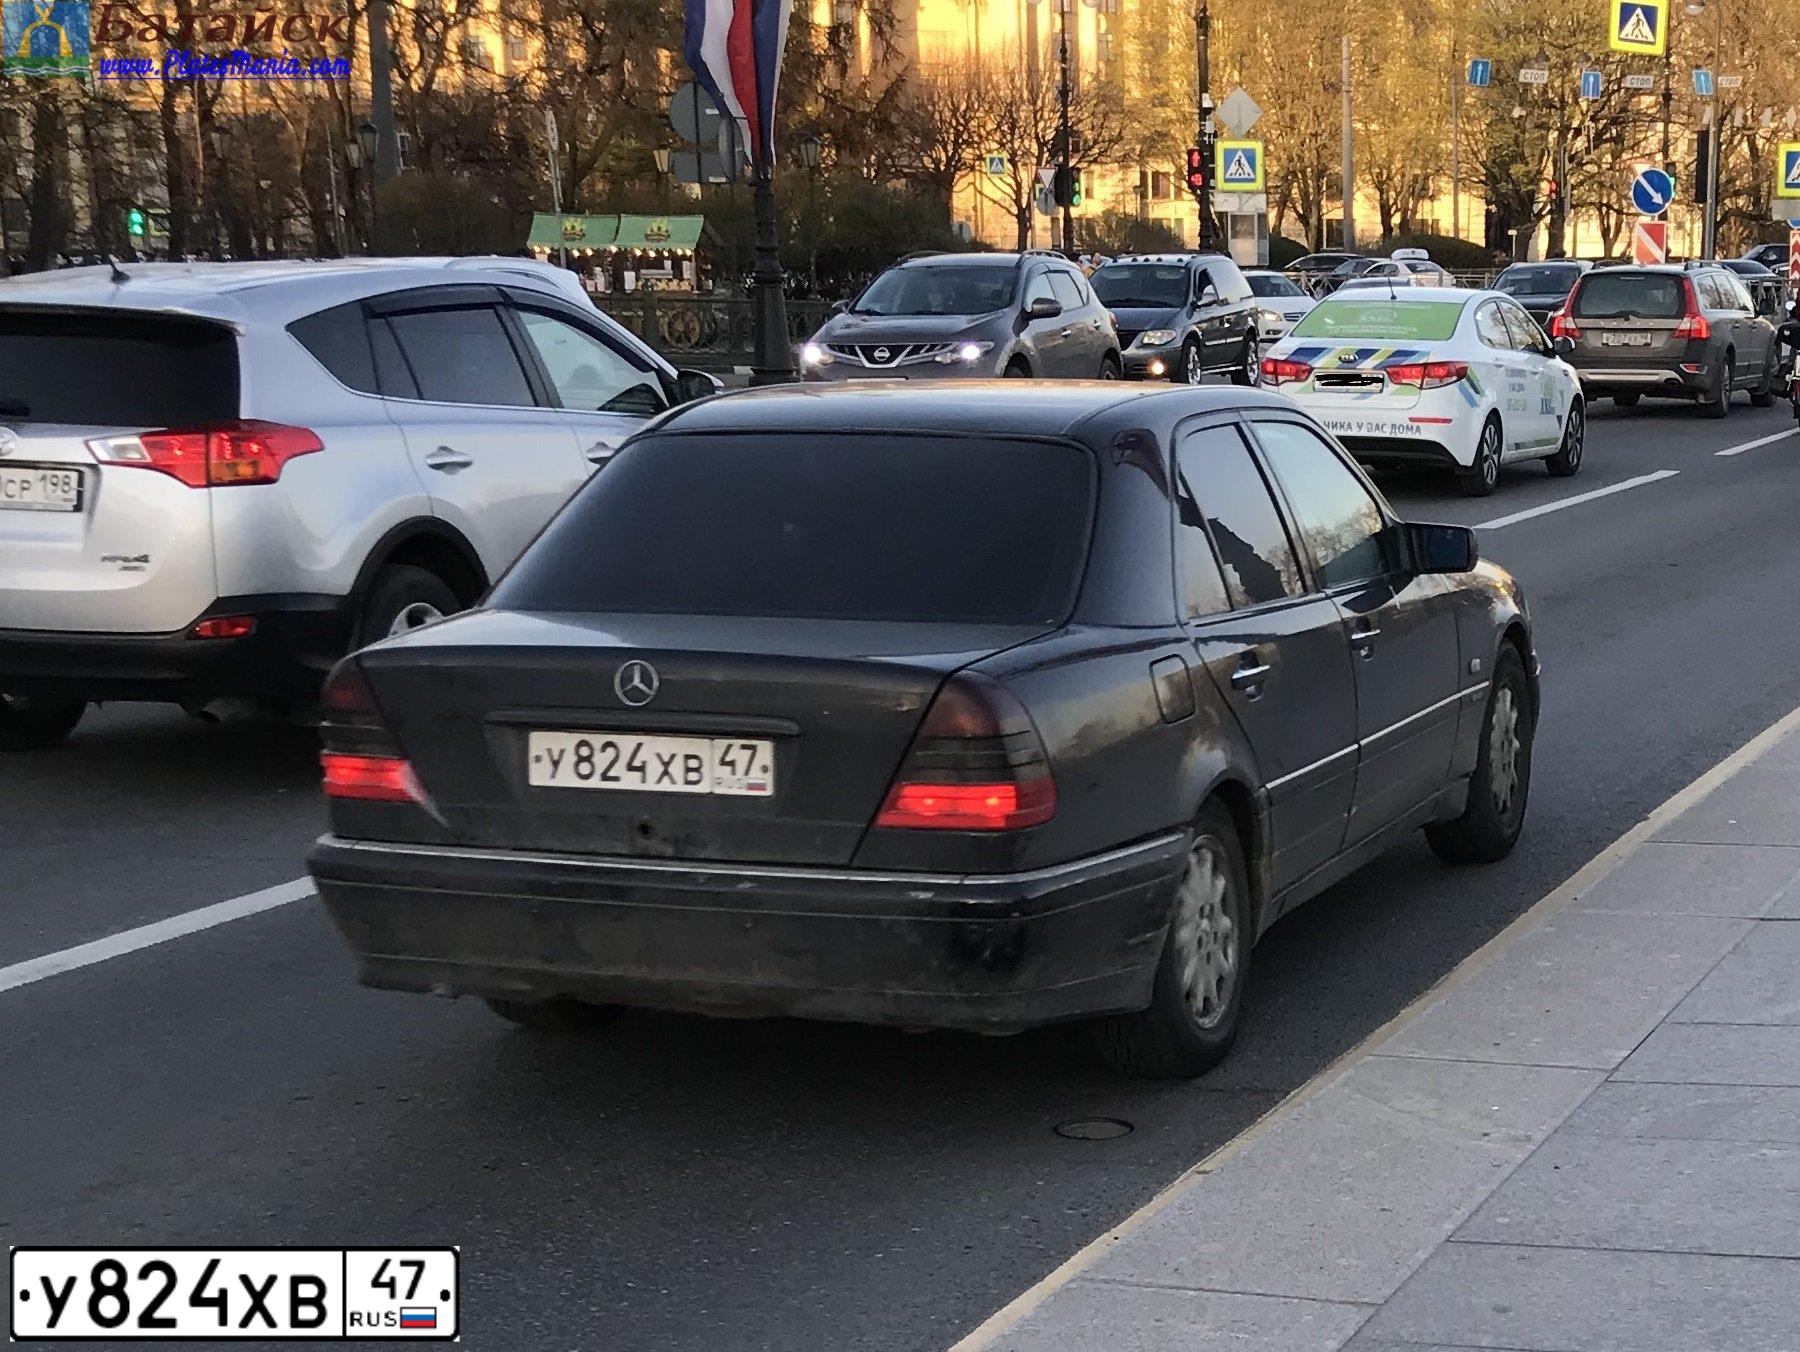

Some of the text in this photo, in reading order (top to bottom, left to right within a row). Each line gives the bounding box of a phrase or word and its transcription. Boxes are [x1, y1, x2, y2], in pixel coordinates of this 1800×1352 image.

[1522, 71, 1546, 82] СТОП
[1628, 76, 1651, 87] СТОП
[1718, 77, 1739, 86] СТОП
[1357, 422, 1363, 433] У
[1367, 423, 1387, 434] ВАС
[1390, 424, 1421, 436] ДОМА
[0, 473, 72, 499] СР 198
[718, 743, 759, 778] 47
